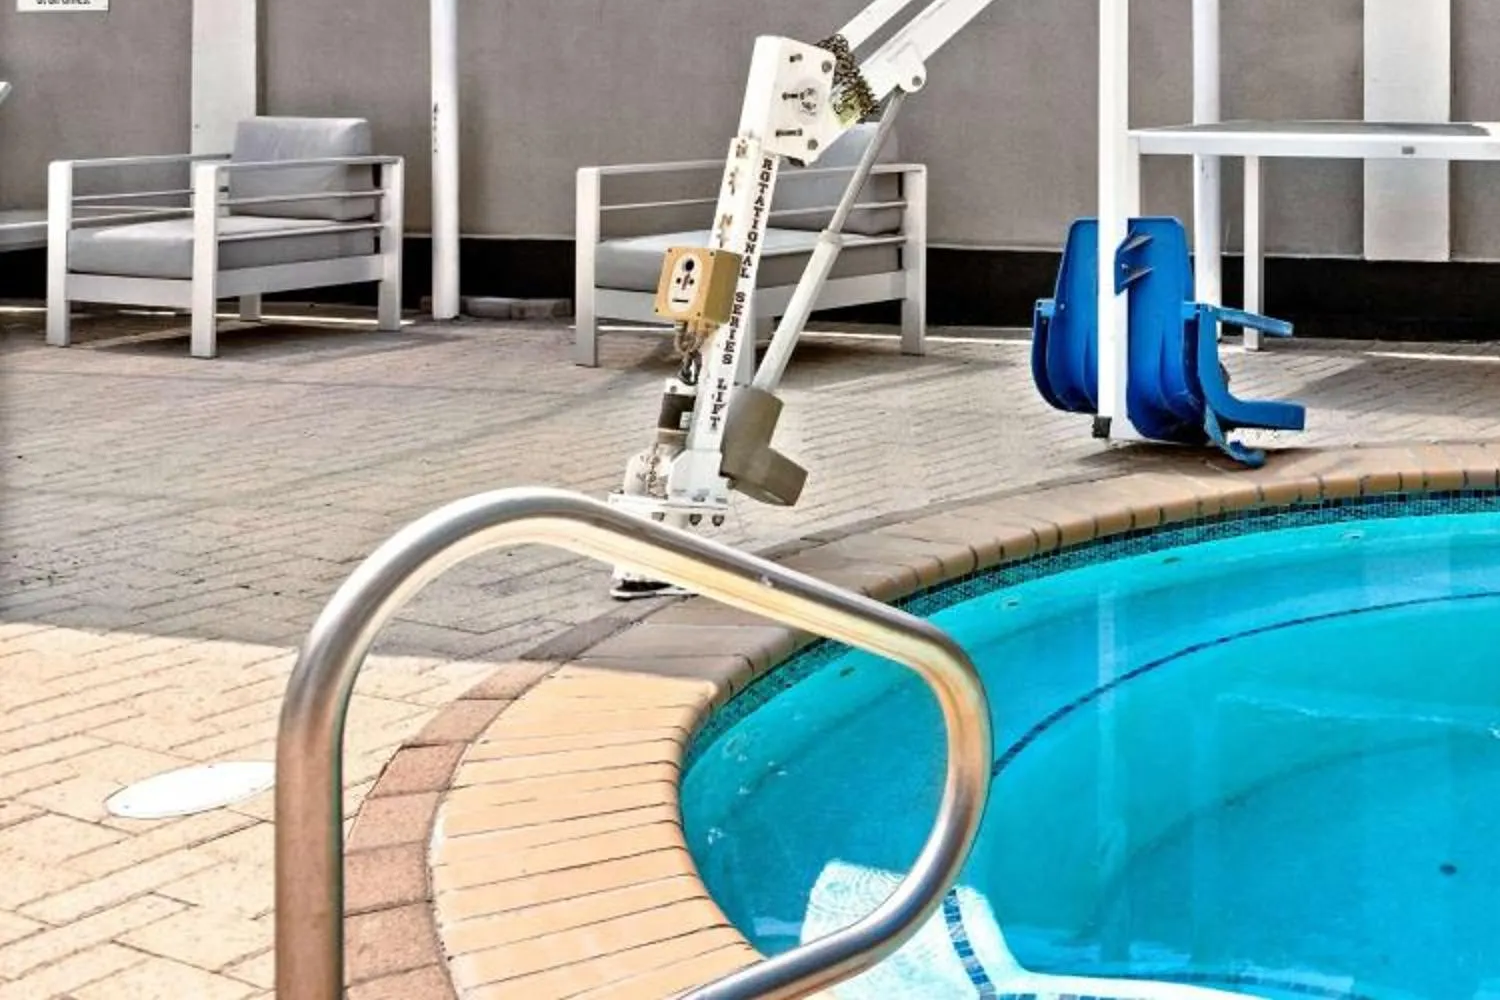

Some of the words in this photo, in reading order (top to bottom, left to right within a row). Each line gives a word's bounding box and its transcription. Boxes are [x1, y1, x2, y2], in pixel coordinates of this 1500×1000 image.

[740, 157, 773, 279] ROTATIONAL
[722, 291, 745, 365] SERIES
[710, 378, 728, 430] LIFT
